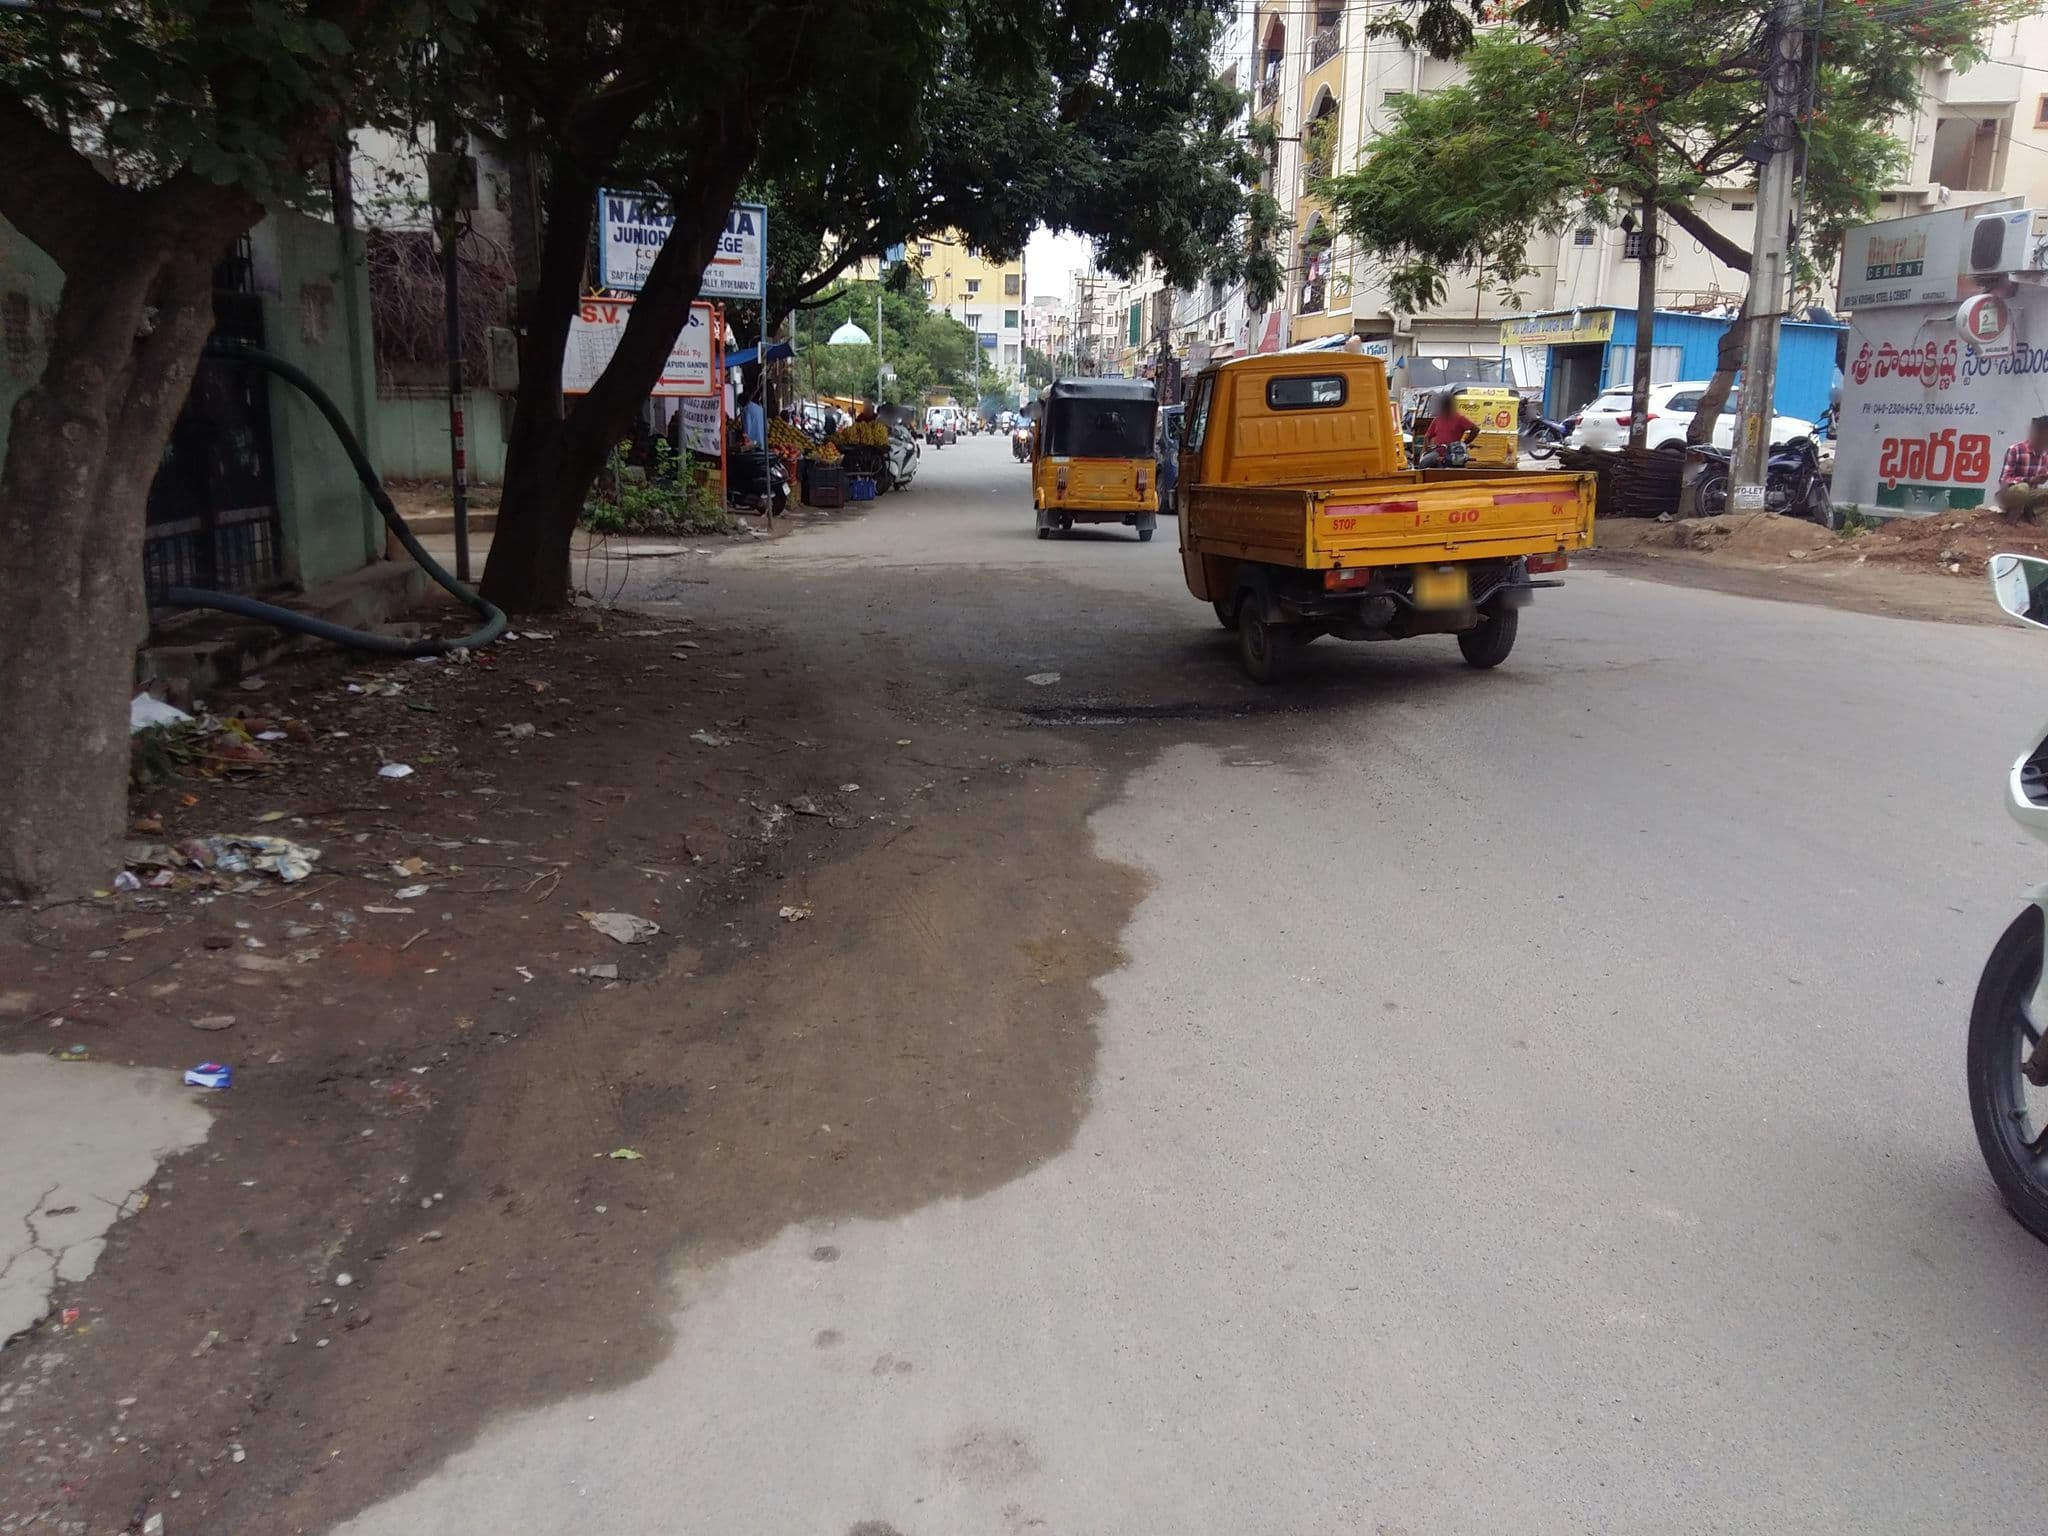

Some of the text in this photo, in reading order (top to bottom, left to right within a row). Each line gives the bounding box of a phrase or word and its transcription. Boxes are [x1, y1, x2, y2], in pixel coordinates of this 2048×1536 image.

[613, 227, 667, 246] JUNIOR
[1867, 263, 1922, 279] CEMENT
[1879, 429, 1991, 489] భారతి
[1333, 518, 1357, 531] STOP
[1552, 504, 1565, 515] OK
